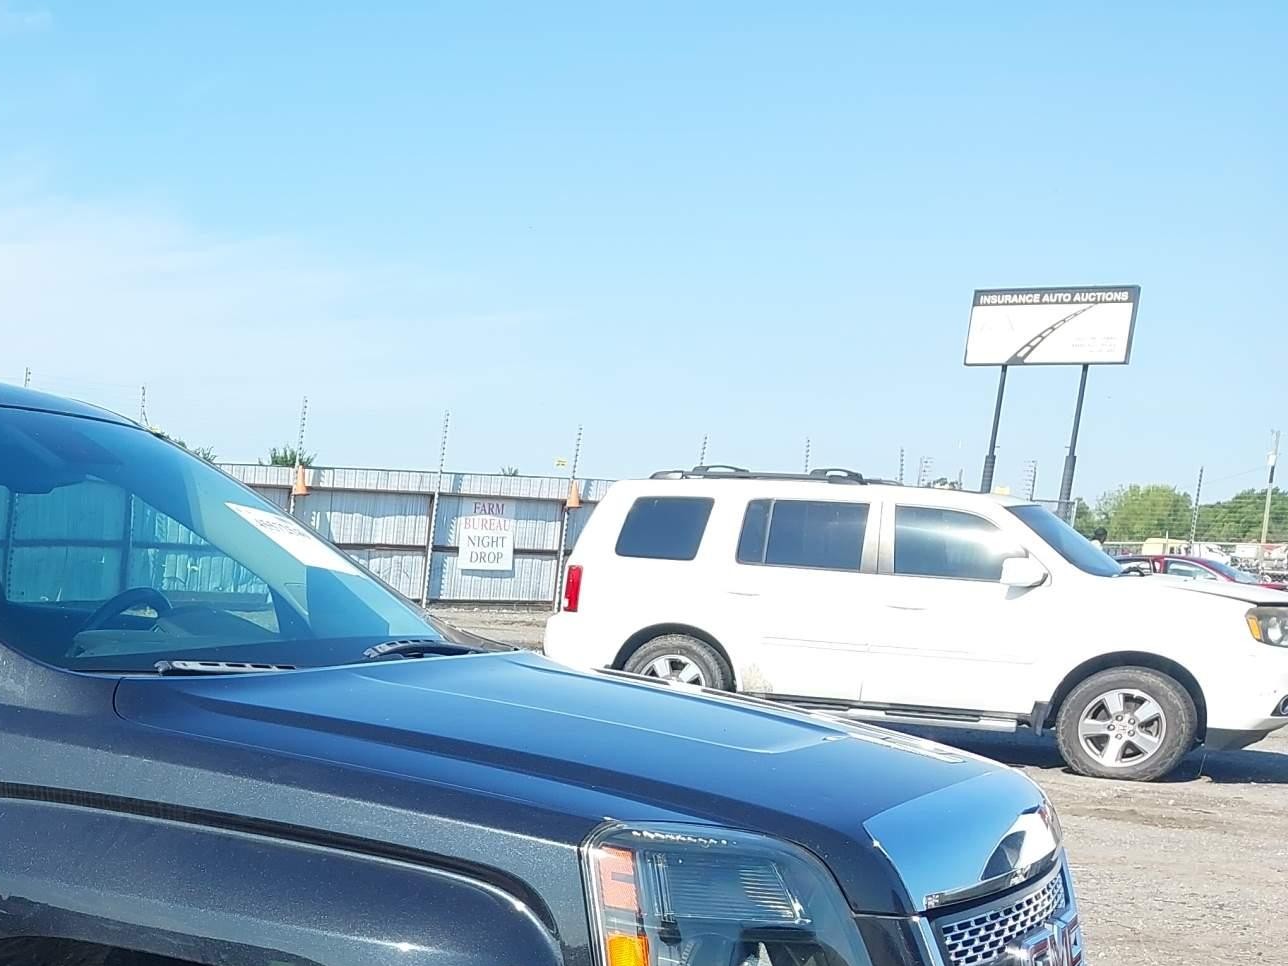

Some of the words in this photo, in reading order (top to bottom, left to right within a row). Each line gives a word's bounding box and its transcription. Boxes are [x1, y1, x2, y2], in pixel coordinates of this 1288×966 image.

[980, 293, 1040, 304] INSURANCE
[1042, 292, 1072, 303] AUTO
[1073, 291, 1129, 302] AUCTIONS
[473, 501, 505, 515] FARM
[464, 518, 511, 531] BUREAU
[467, 535, 507, 548] NIGHT
[469, 551, 504, 564] DROP
